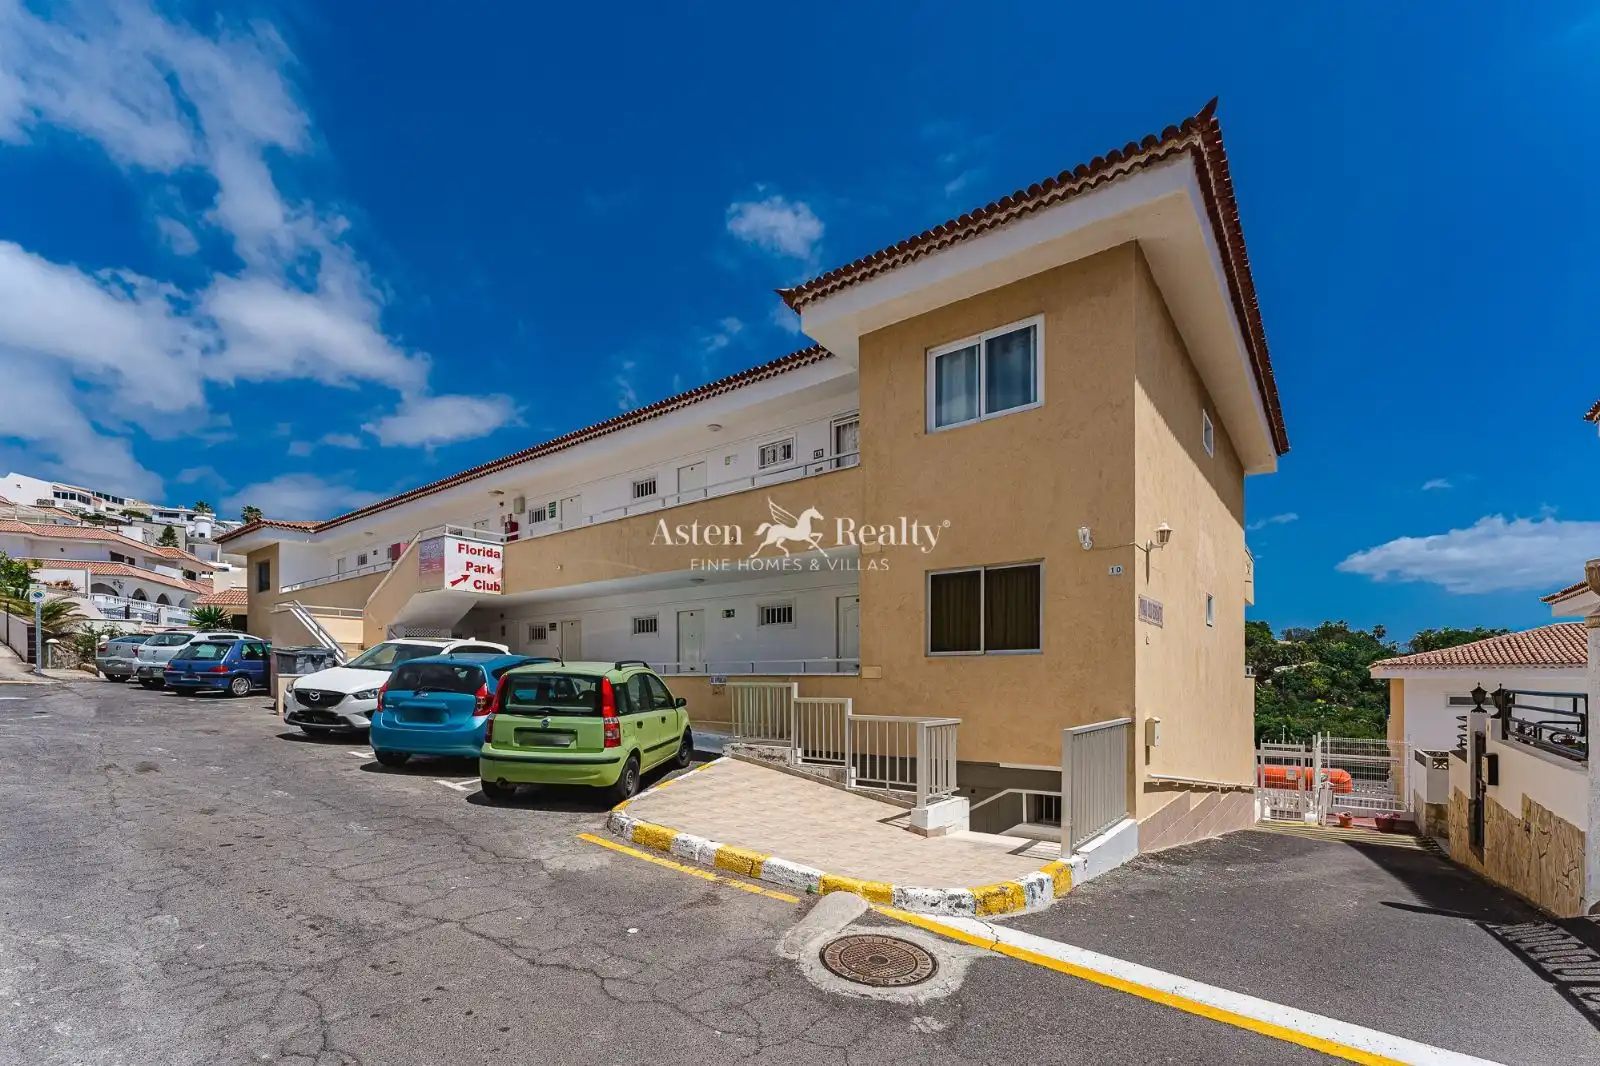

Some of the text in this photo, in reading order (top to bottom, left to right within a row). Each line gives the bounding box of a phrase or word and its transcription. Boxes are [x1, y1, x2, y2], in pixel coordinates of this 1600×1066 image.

[457, 543, 501, 558] Florida
[465, 561, 495, 575] Park
[473, 579, 501, 592] Club
